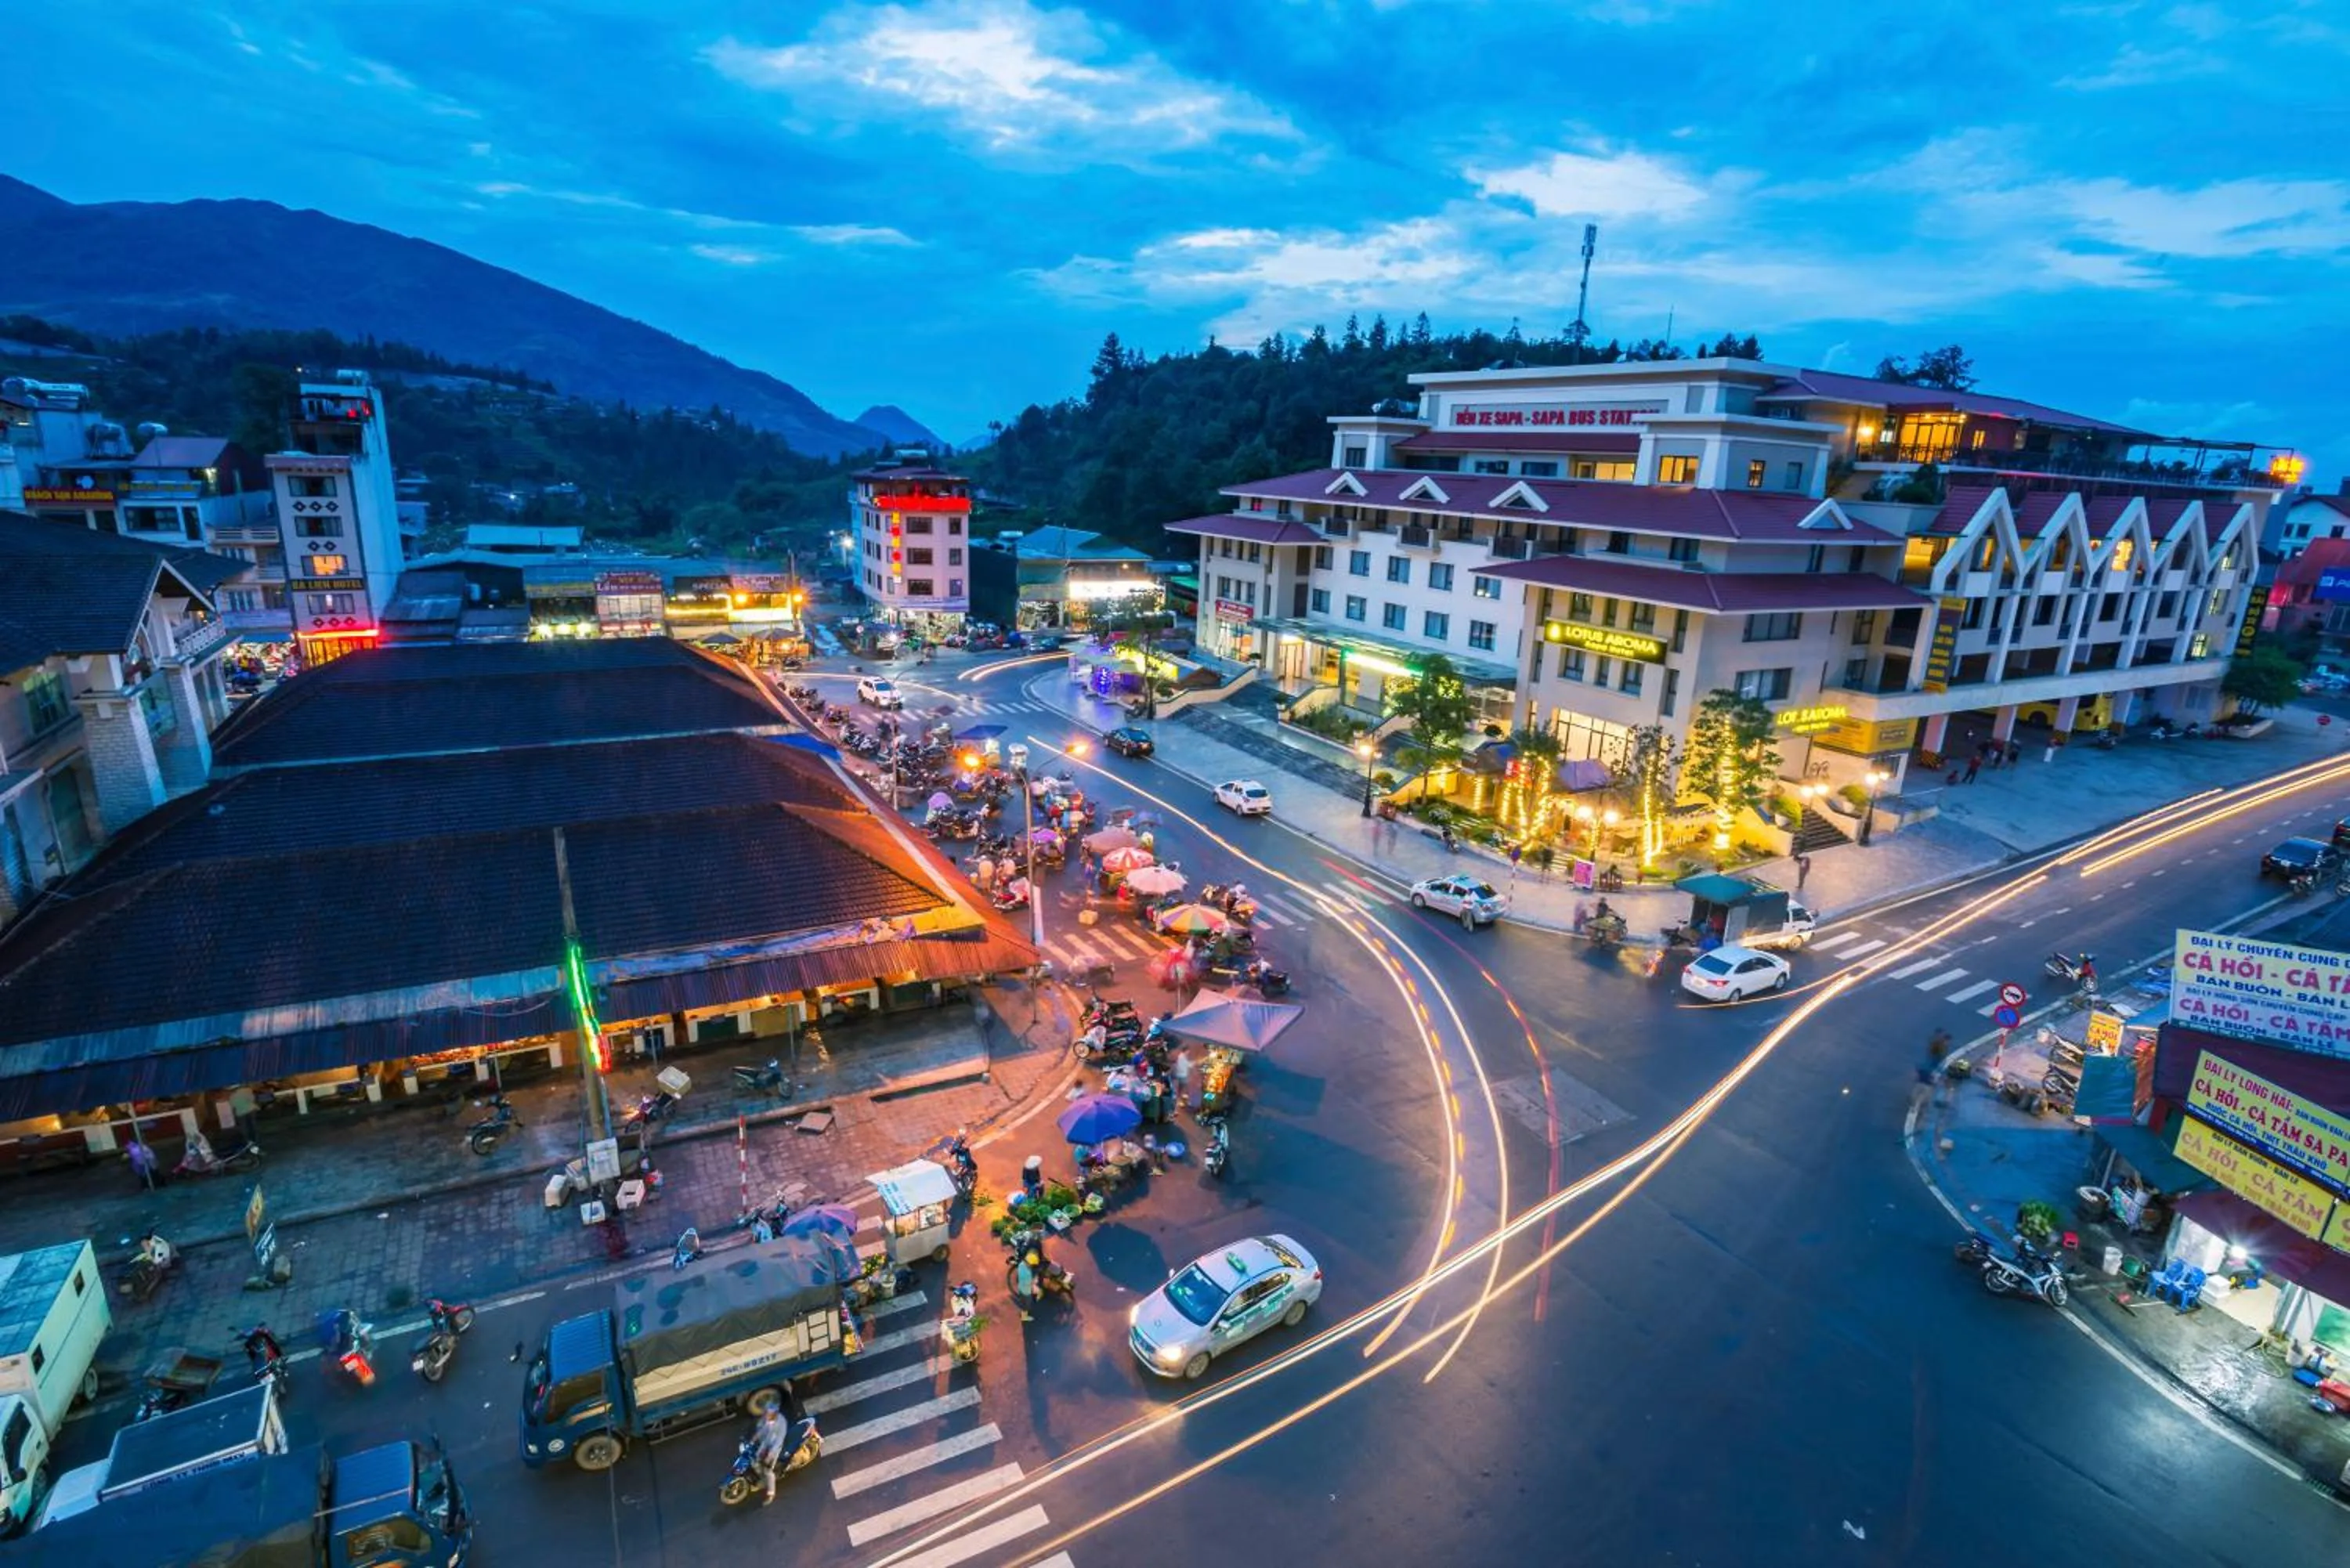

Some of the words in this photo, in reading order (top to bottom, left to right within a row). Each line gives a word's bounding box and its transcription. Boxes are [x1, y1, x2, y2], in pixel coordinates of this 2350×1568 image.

[1494, 410, 1523, 425] SAPA
[1531, 410, 1565, 425] SAPA
[1569, 410, 1595, 425] BUS
[1566, 626, 1603, 642] LOTUS
[1605, 633, 1658, 655] AROMA
[2183, 950, 2213, 971] CÁ
[2286, 967, 2320, 990] CÁ
[2298, 952, 2340, 966] CUNG
[2304, 1133, 2323, 1154] SA
[2327, 1143, 2348, 1168] PA
